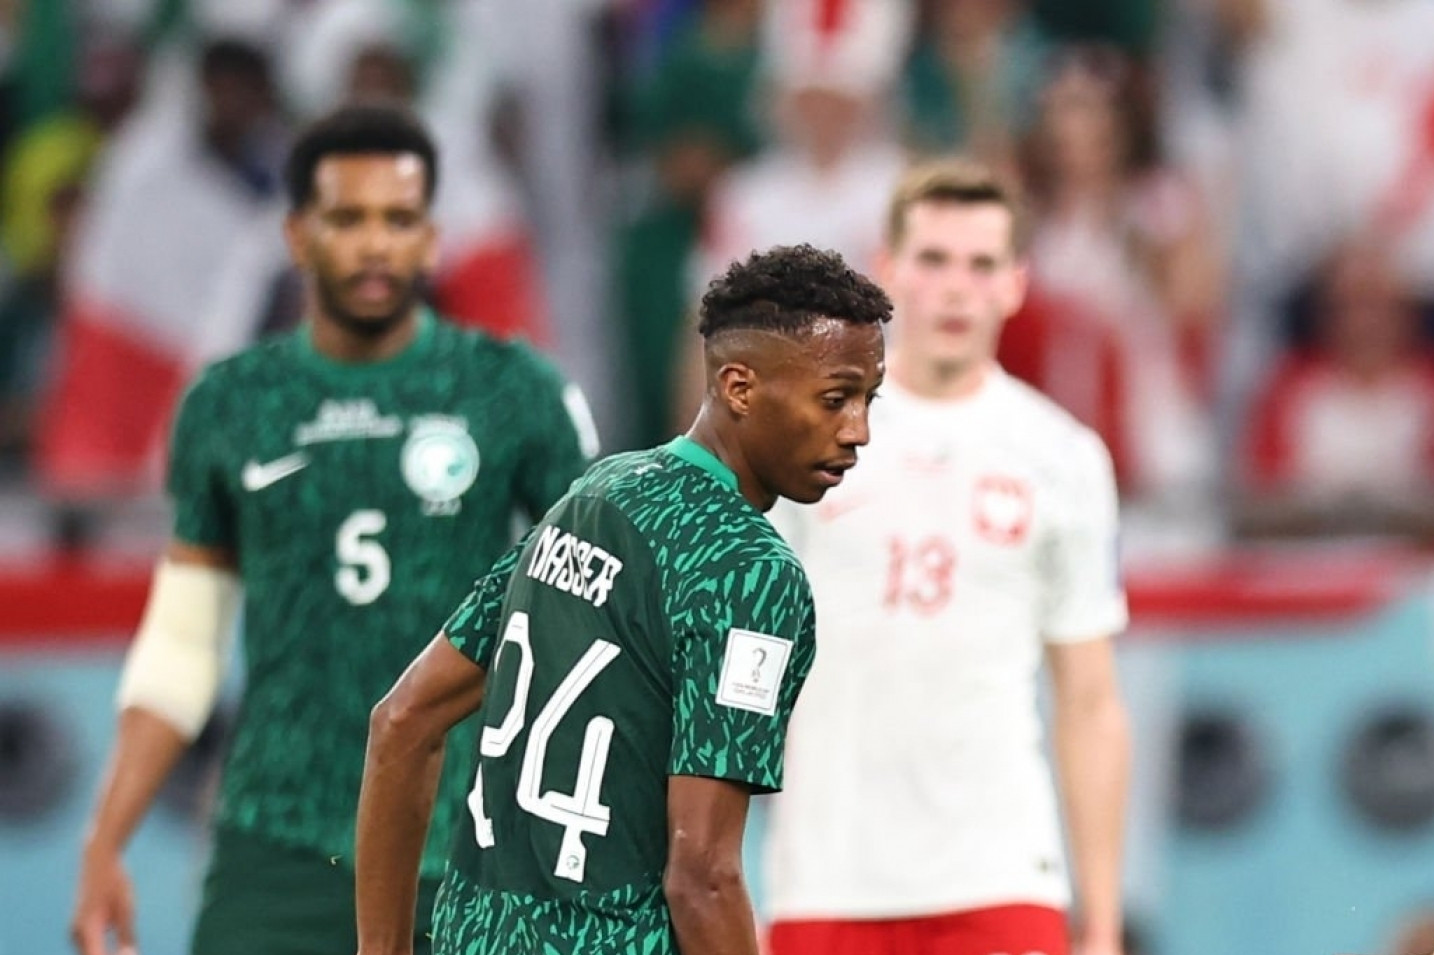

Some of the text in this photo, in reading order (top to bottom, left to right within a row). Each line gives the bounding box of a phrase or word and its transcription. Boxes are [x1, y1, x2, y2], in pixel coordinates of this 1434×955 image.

[335, 508, 390, 605] 5
[526, 525, 624, 608] NASSER
[880, 534, 957, 618] 13
